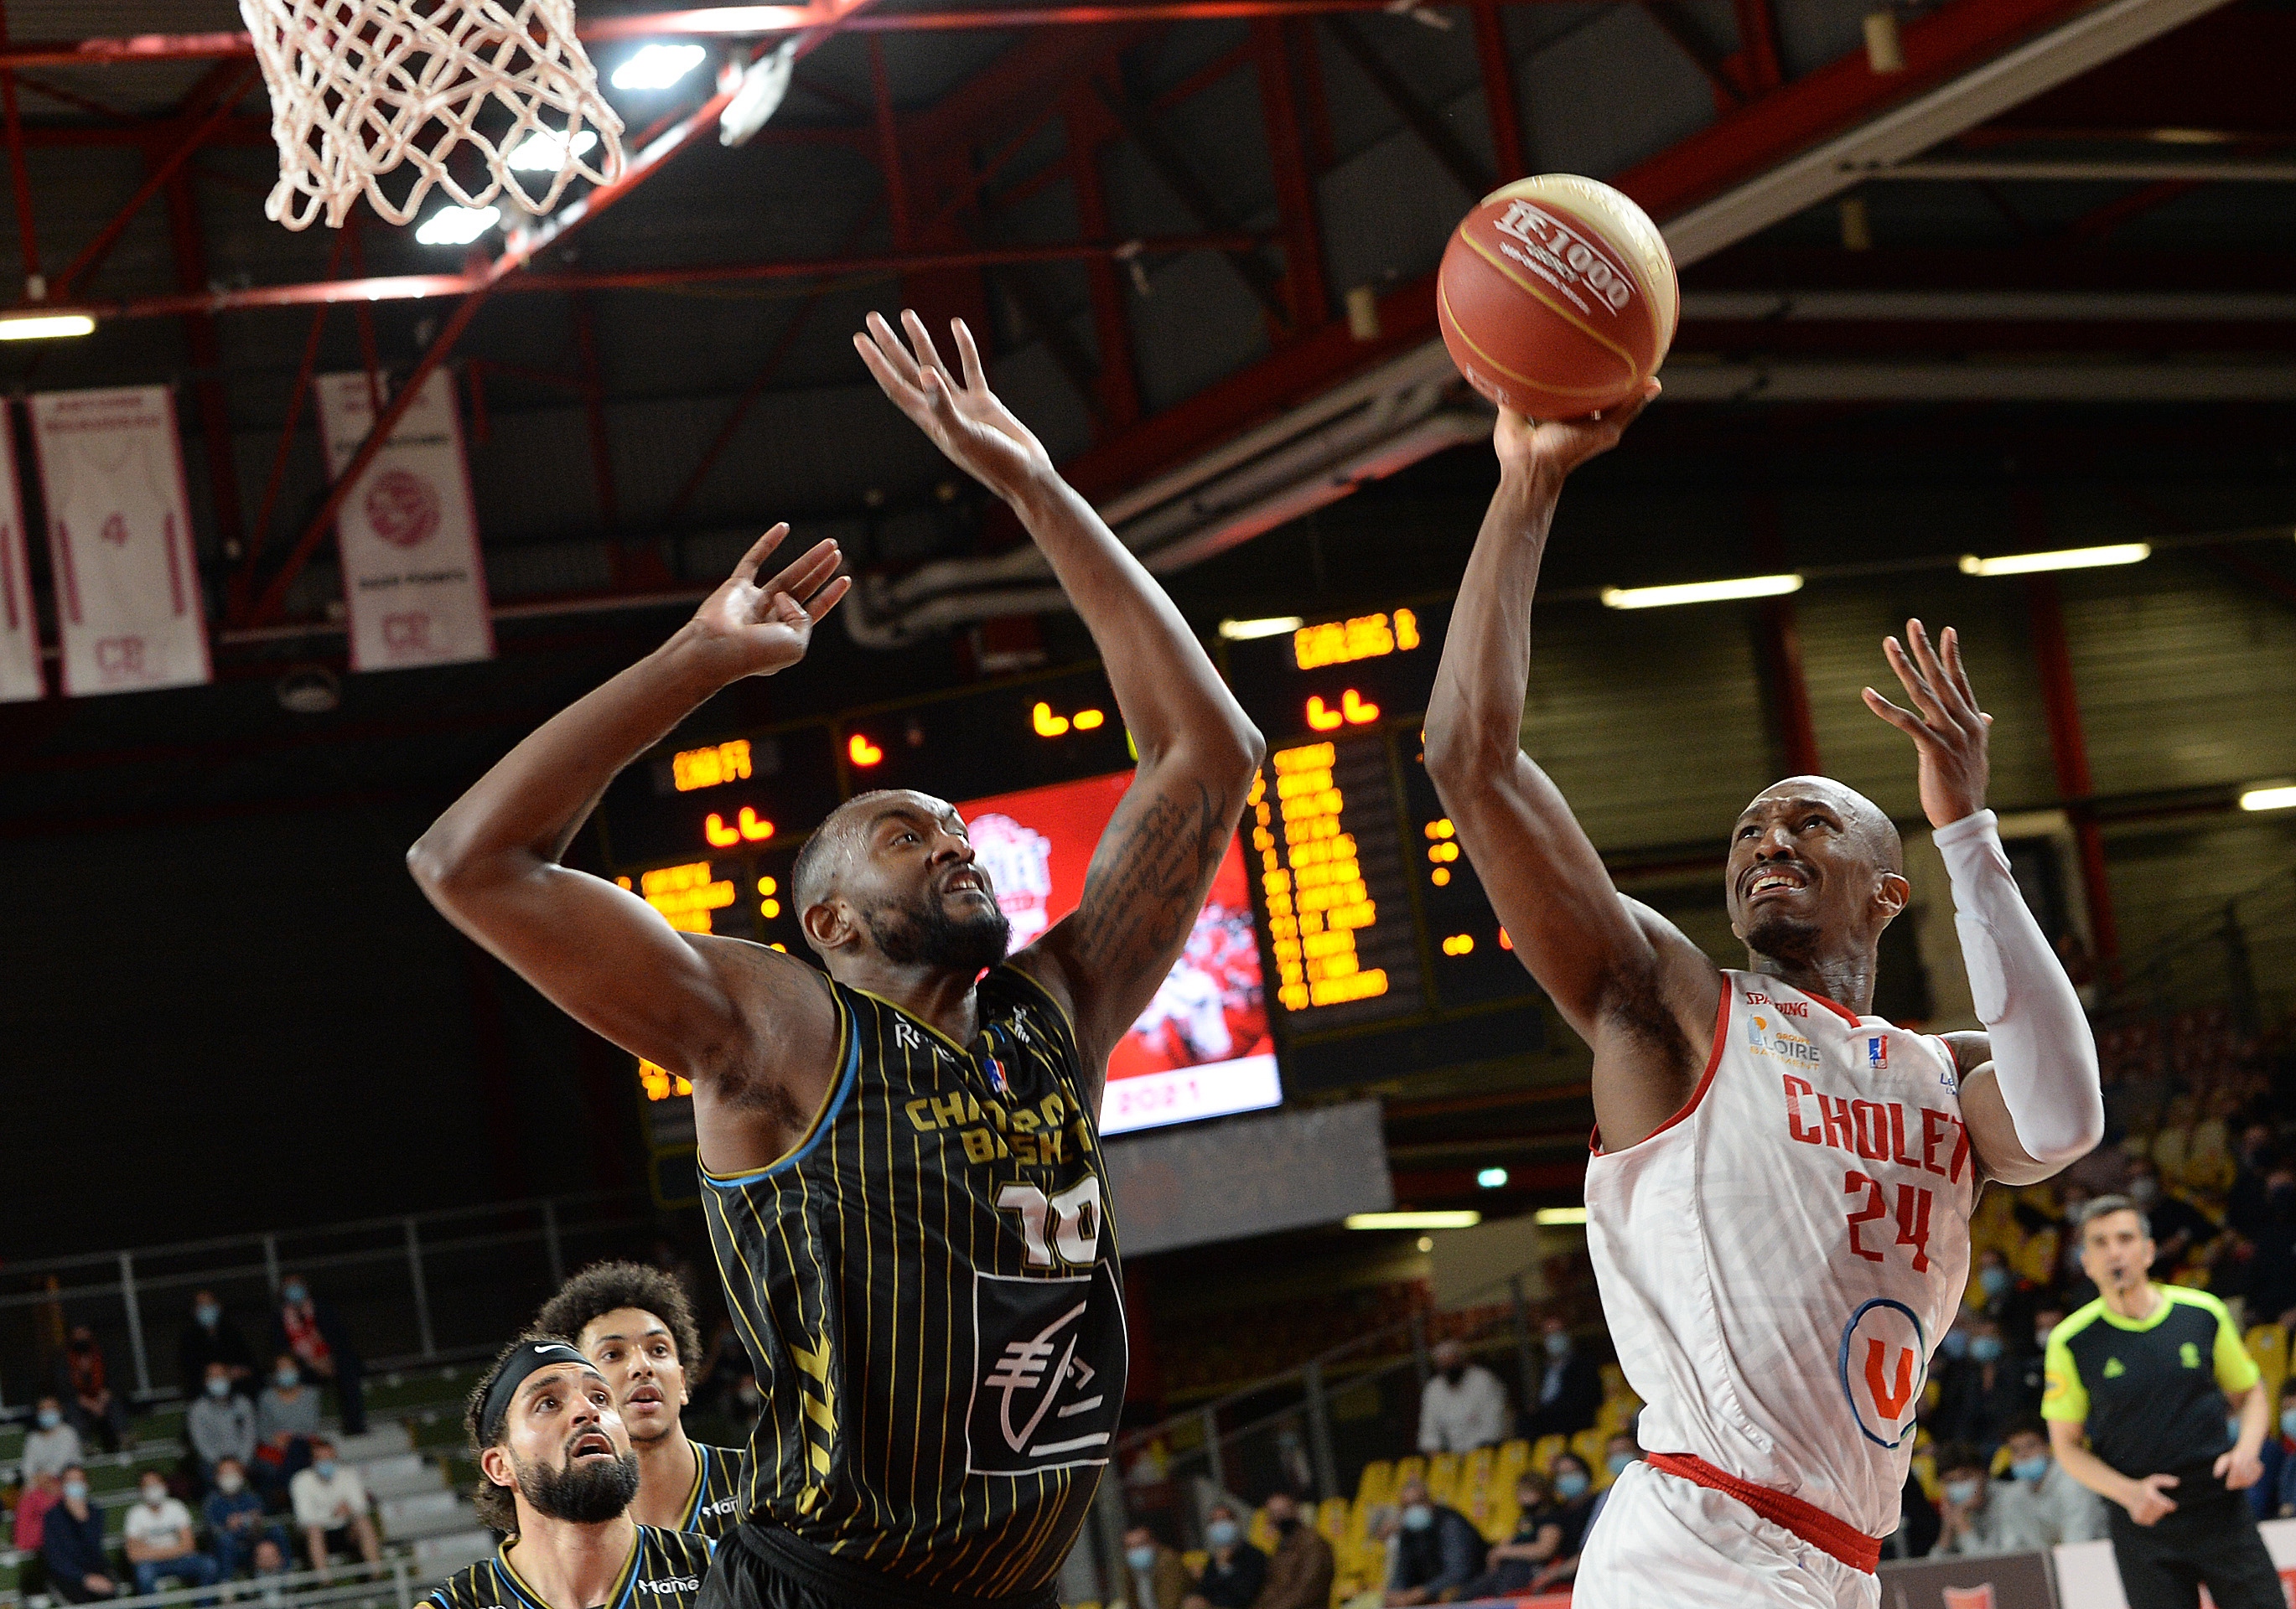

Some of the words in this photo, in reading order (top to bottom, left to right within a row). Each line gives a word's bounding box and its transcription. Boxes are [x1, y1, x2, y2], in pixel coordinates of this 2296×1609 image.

[101, 512, 129, 547] 4
[1746, 991, 1808, 1017] SPADING
[1763, 1037, 1819, 1061] LOIRE
[1783, 1074, 1969, 1184] CHOLET
[996, 1176, 1100, 1268] 10
[1845, 1171, 1932, 1273] 24
[1865, 1337, 1914, 1420] U
